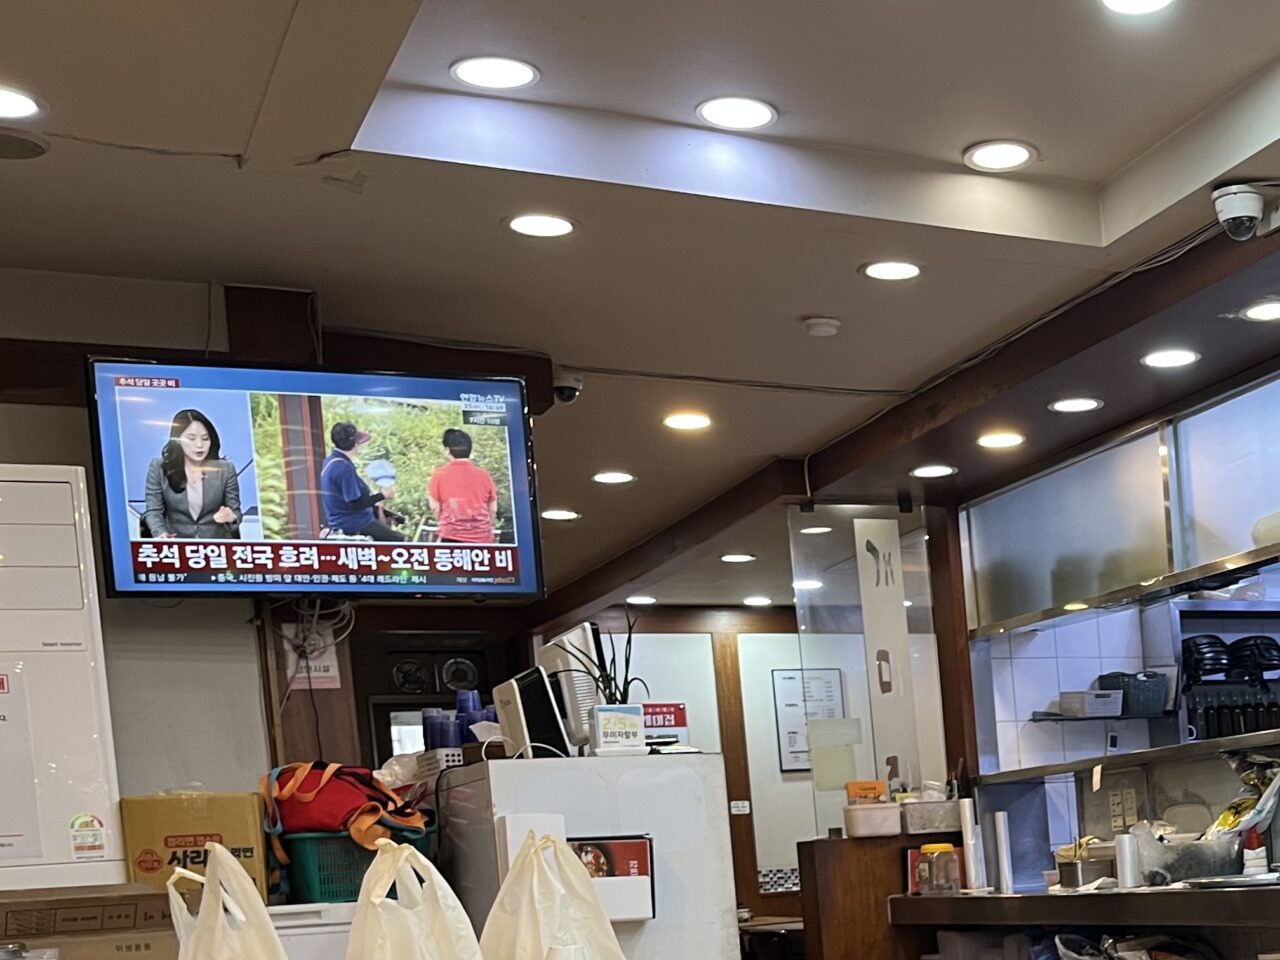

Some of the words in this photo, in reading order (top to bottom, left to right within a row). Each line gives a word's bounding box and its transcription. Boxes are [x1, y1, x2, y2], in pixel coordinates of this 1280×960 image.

[137, 544, 181, 569] 추석
[186, 545, 228, 569] 당일
[232, 545, 275, 570] 전국
[434, 549, 491, 572] 동해안
[495, 549, 514, 572] 비
